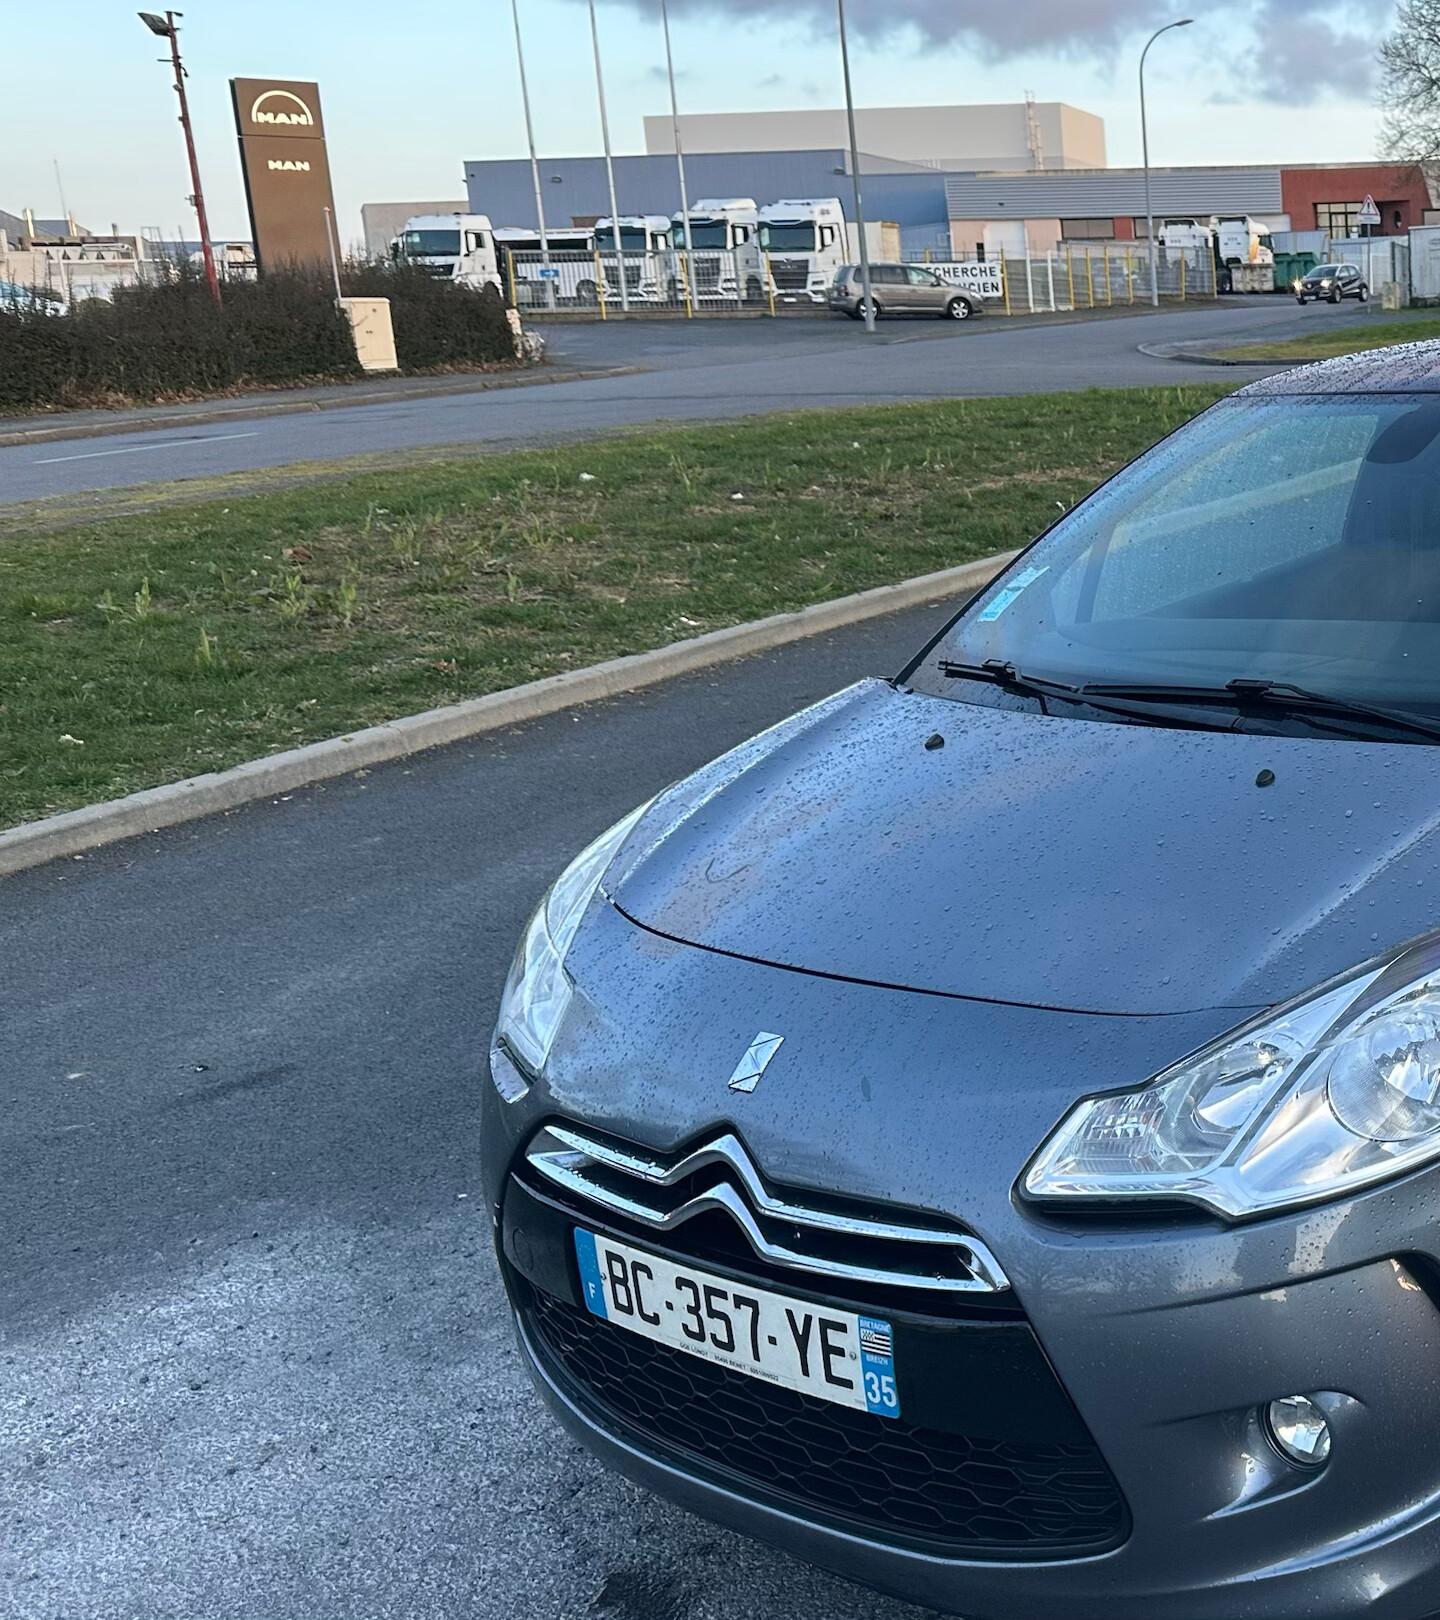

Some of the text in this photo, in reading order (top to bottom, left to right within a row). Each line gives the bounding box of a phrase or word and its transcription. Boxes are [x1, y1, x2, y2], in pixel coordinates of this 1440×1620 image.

[257, 112, 308, 125] MAN
[268, 160, 310, 171] MAN
[588, 1281, 596, 1298] F
[865, 1371, 897, 1408] 35
